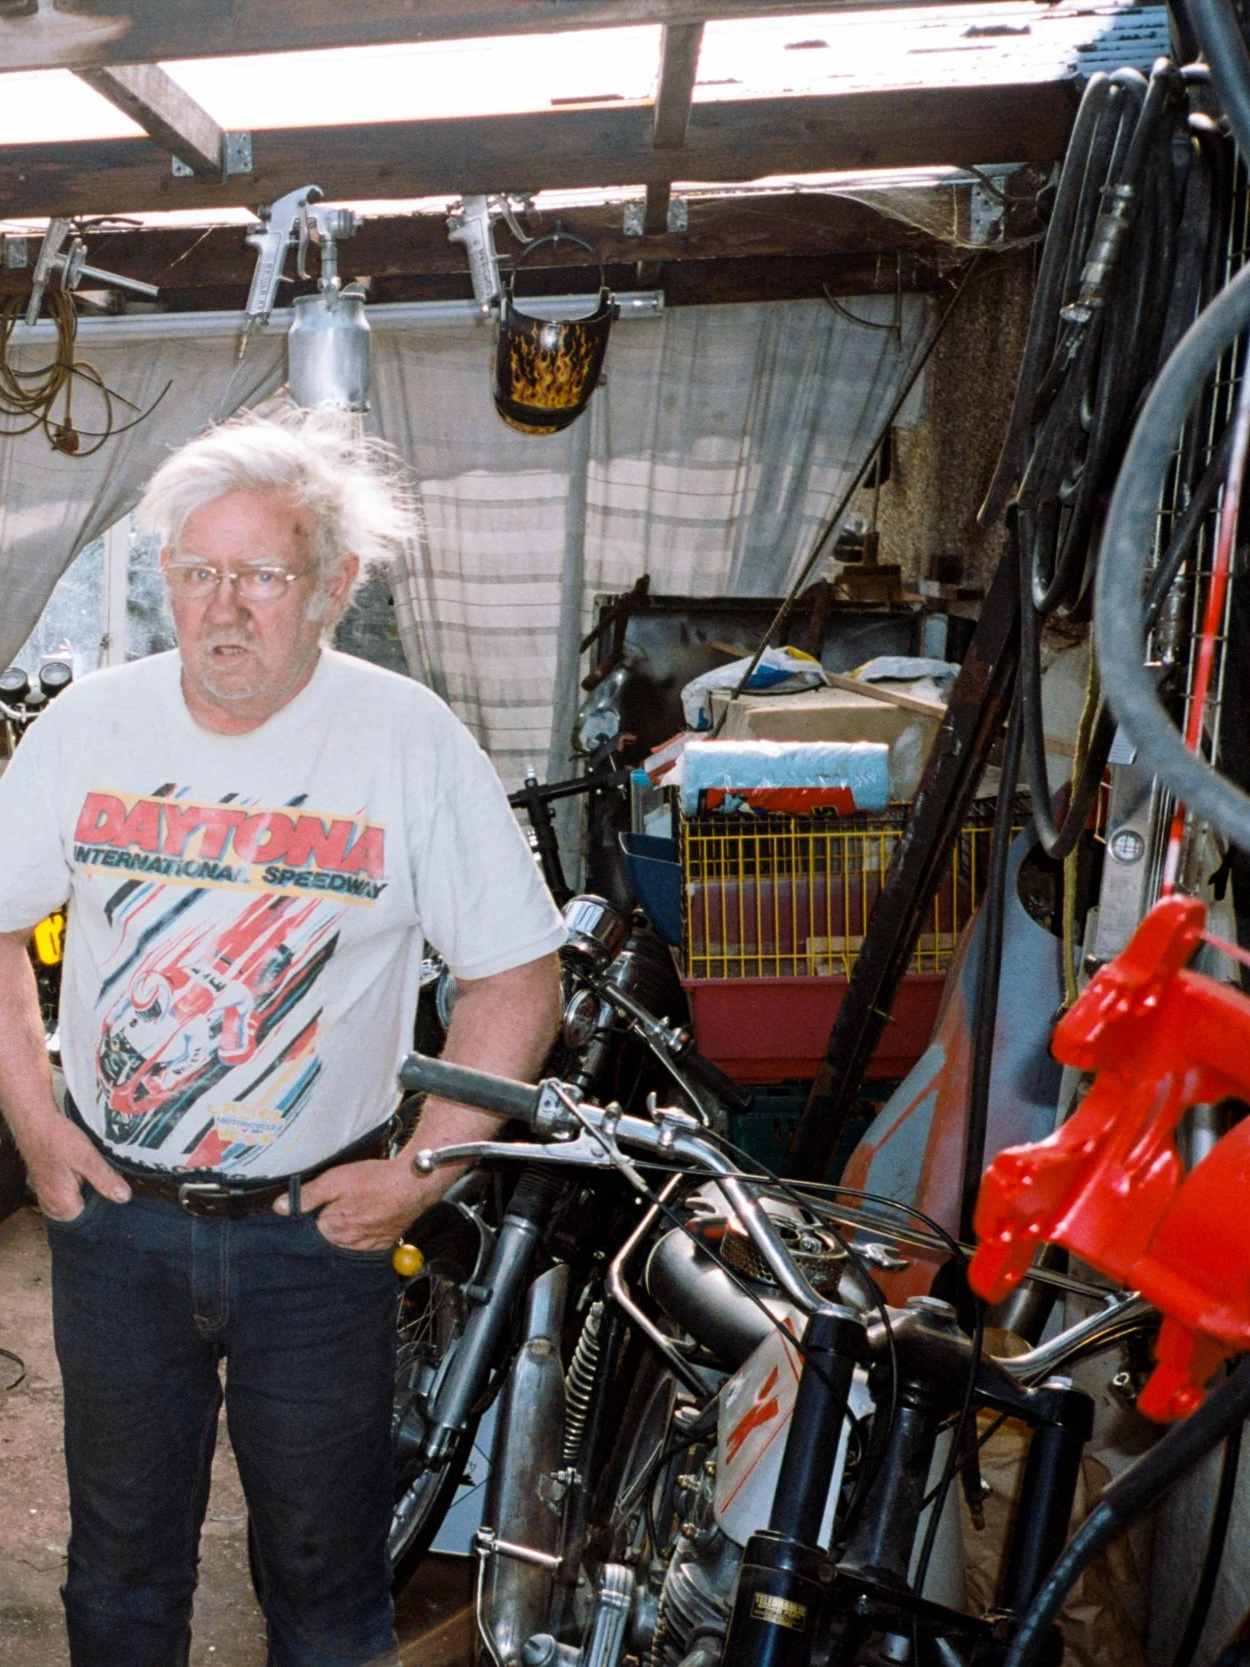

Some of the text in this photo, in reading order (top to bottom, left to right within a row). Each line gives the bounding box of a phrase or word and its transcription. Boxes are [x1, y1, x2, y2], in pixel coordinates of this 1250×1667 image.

[74, 792, 385, 880] DAYTONA
[74, 845, 250, 884] INTERNATIONAL
[262, 866, 389, 899] SPEEDWAY
